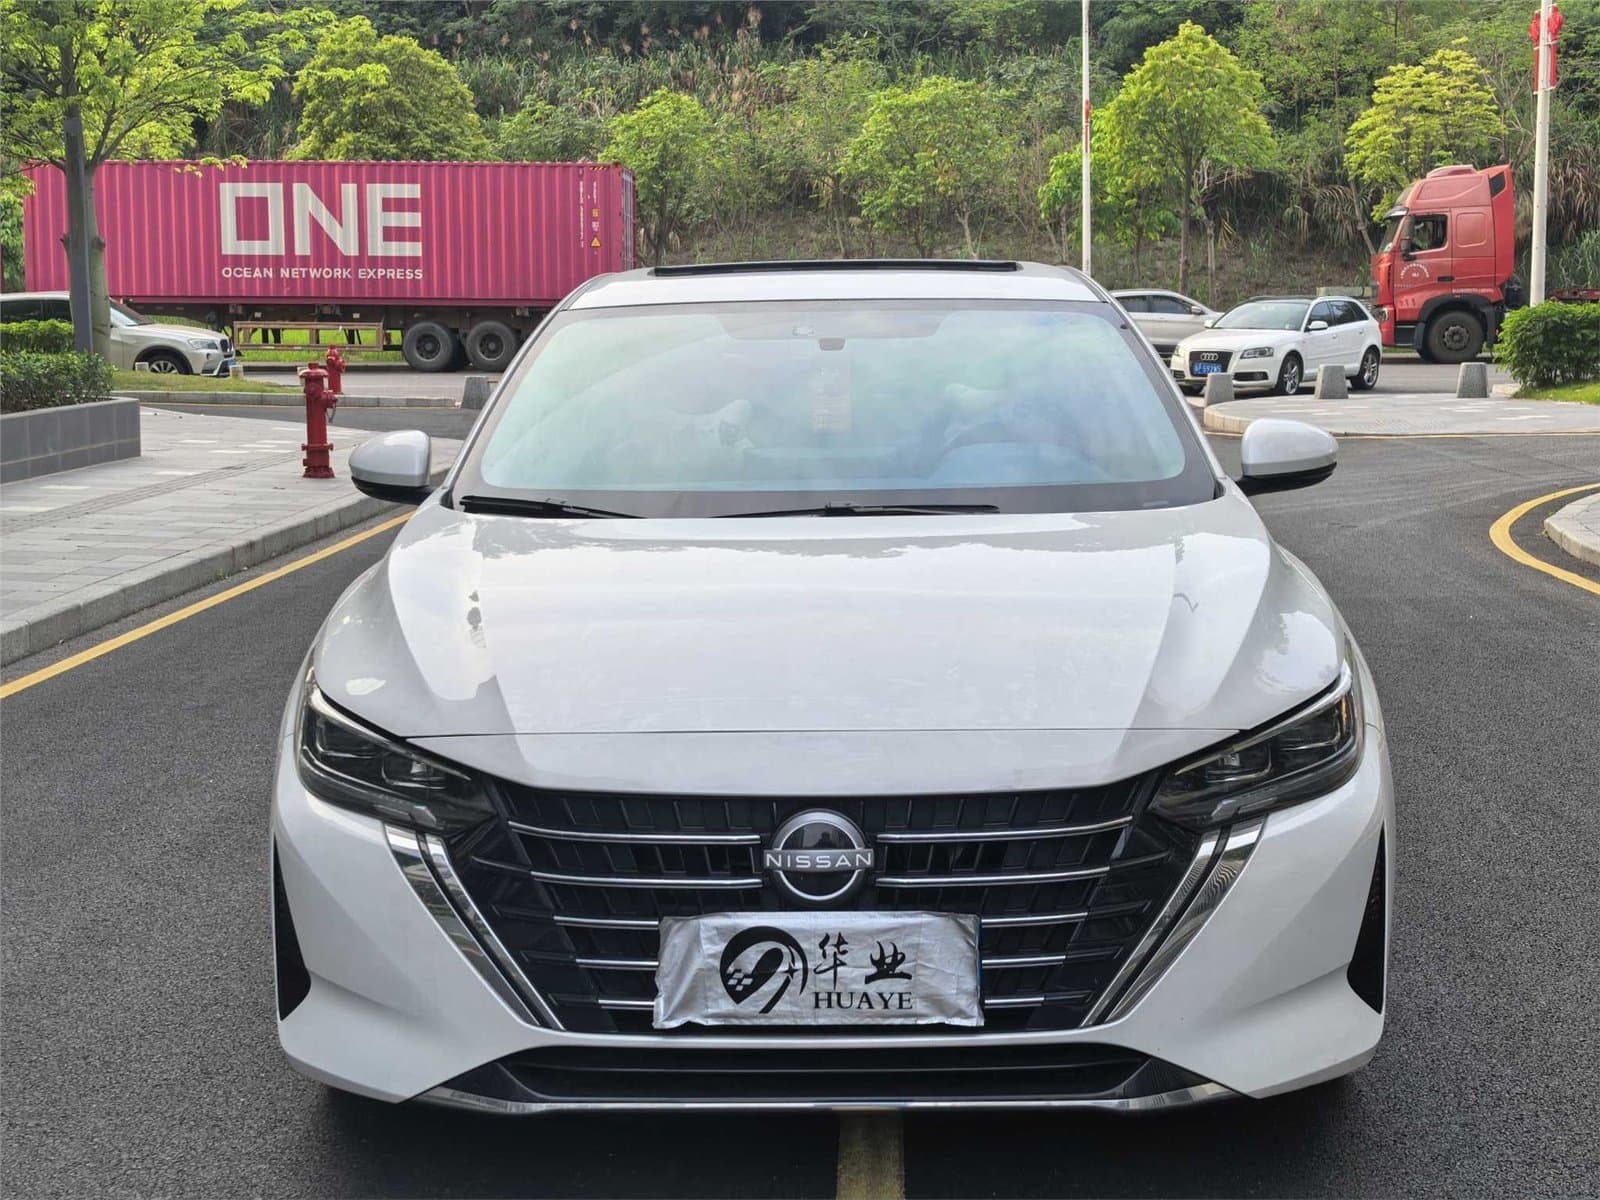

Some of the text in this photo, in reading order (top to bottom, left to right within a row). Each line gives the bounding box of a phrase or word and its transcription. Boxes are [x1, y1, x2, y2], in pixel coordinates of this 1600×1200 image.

[219, 182, 422, 257] ONE
[221, 267, 424, 280] OCEAN NETWORK EXPRESS
[766, 853, 872, 868] NISSAN
[813, 931, 912, 990] 华业
[813, 991, 913, 1010] HUAYE
